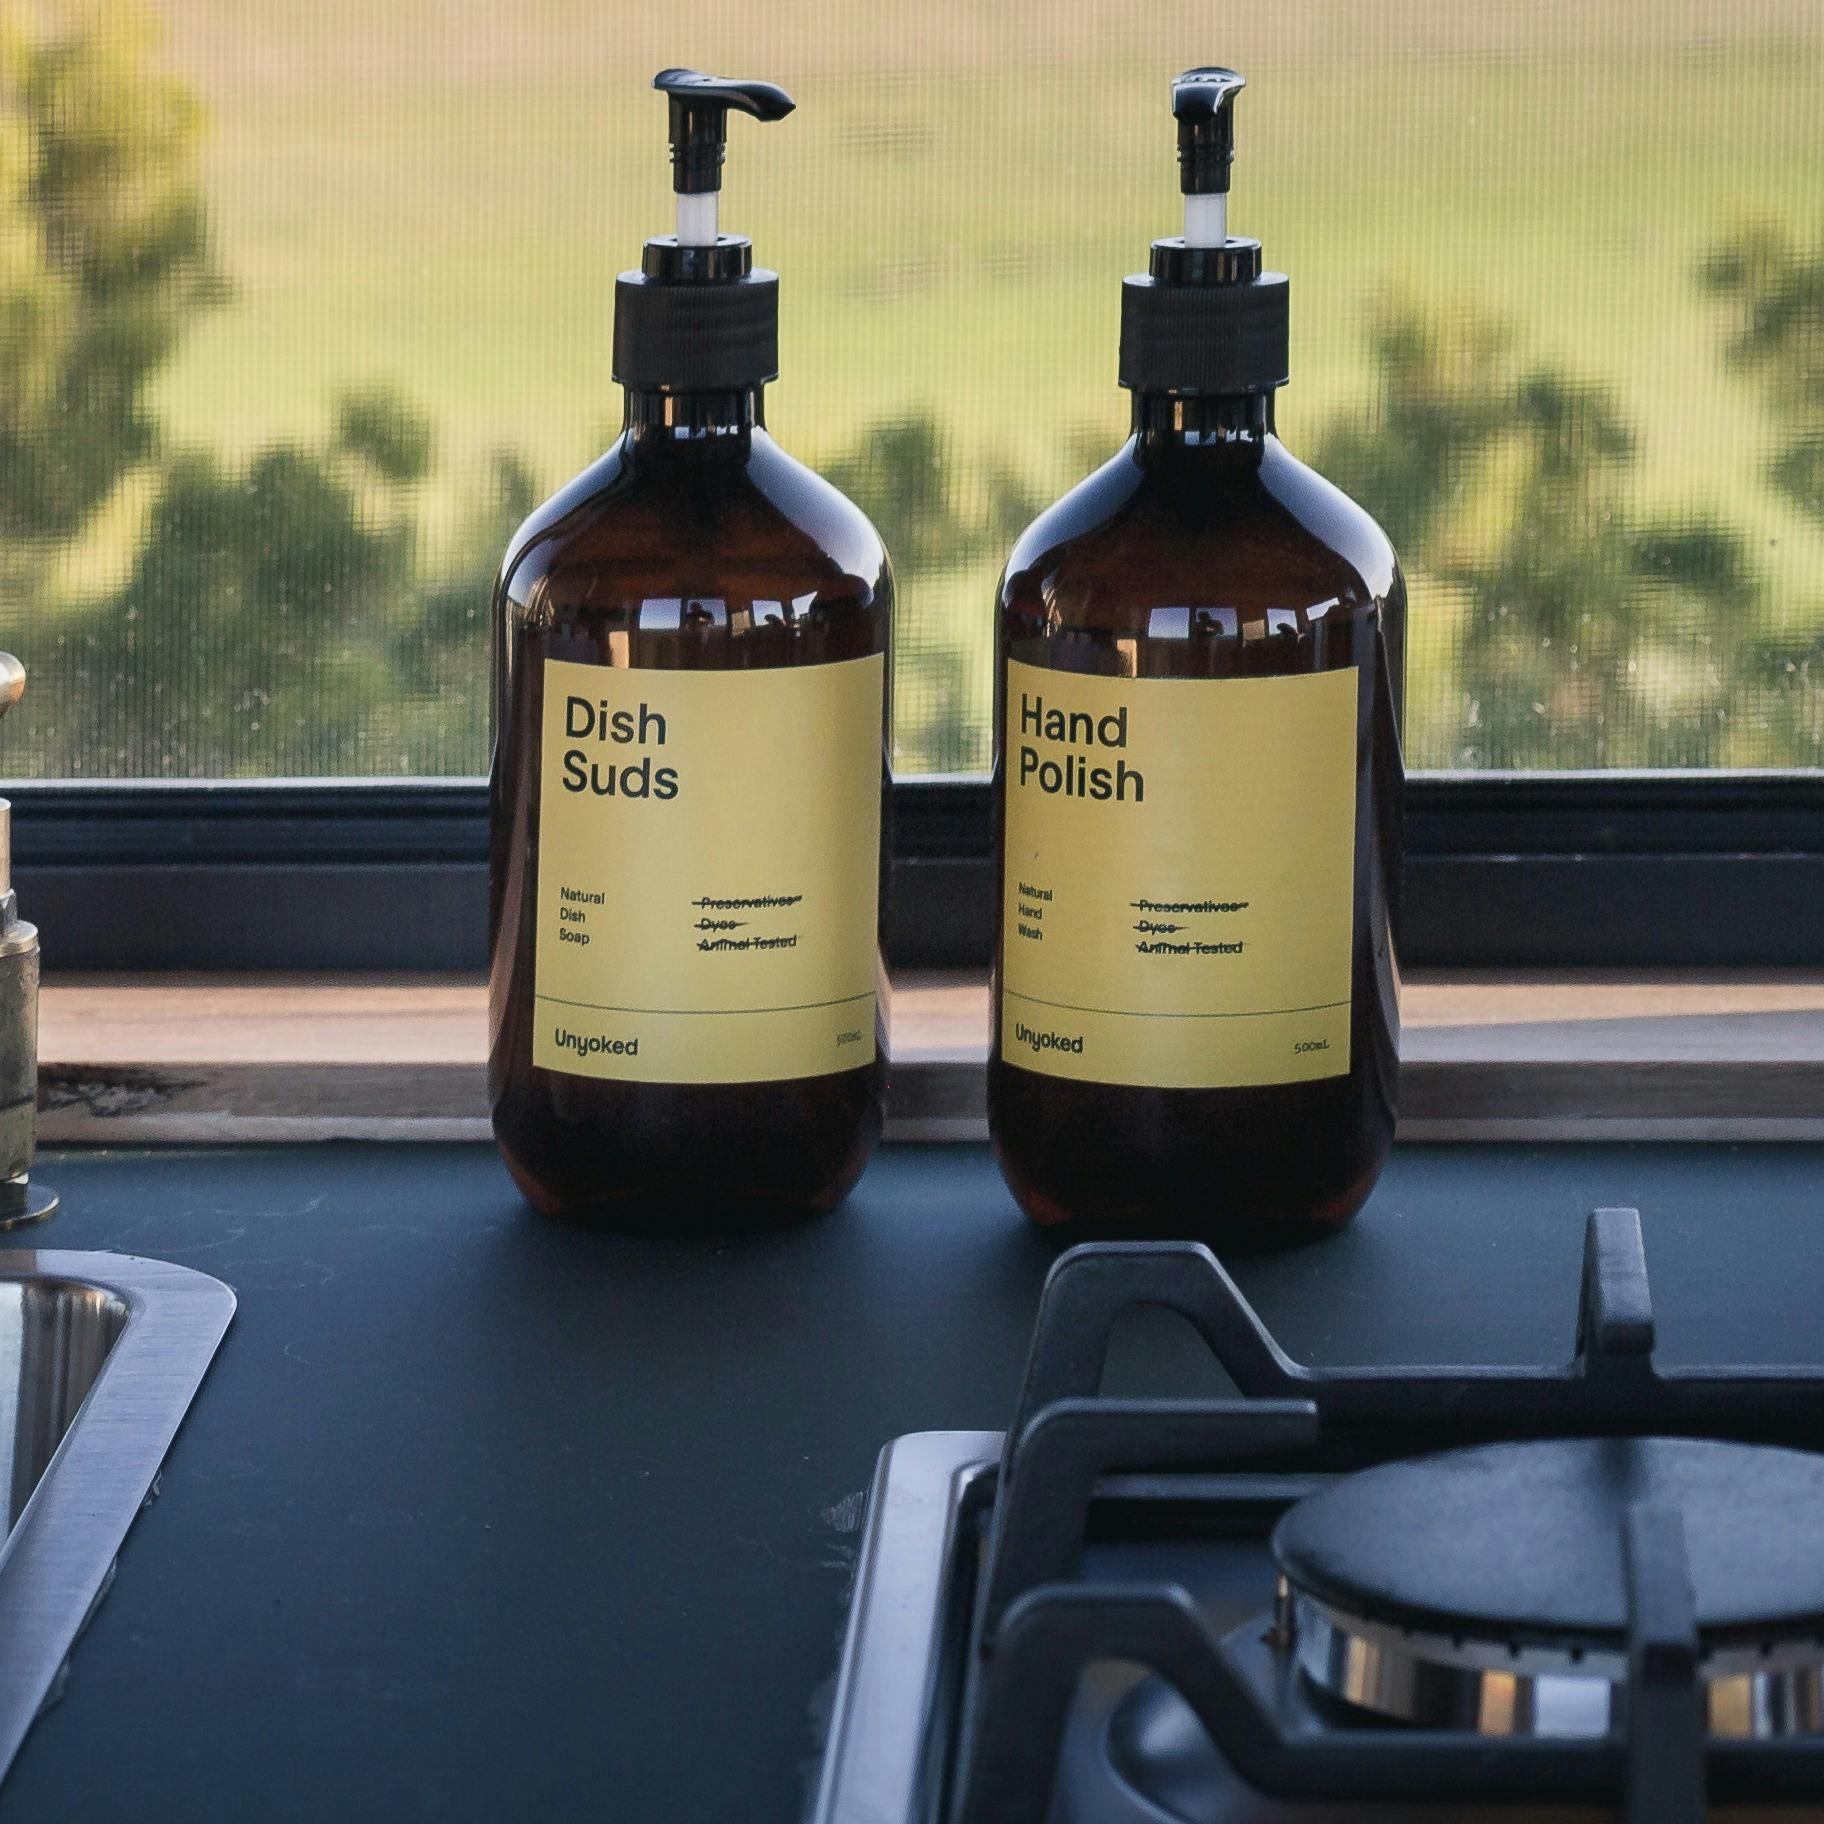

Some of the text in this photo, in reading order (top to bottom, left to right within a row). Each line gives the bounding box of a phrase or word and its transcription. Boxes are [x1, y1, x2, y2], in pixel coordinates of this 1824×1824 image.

[565, 695, 667, 745] Dish
[1020, 693, 1128, 749] Hand
[562, 749, 679, 800] Suds
[1020, 746, 1145, 802] Polish
[560, 886, 606, 905] Natural
[1018, 882, 1053, 902] Natural
[559, 907, 587, 923] Dish
[1017, 903, 1043, 921] Hand
[559, 927, 591, 946] Soap
[1017, 923, 1044, 941] Wash
[554, 1028, 639, 1057] Unyoked
[1015, 1022, 1084, 1054] Unyoked
